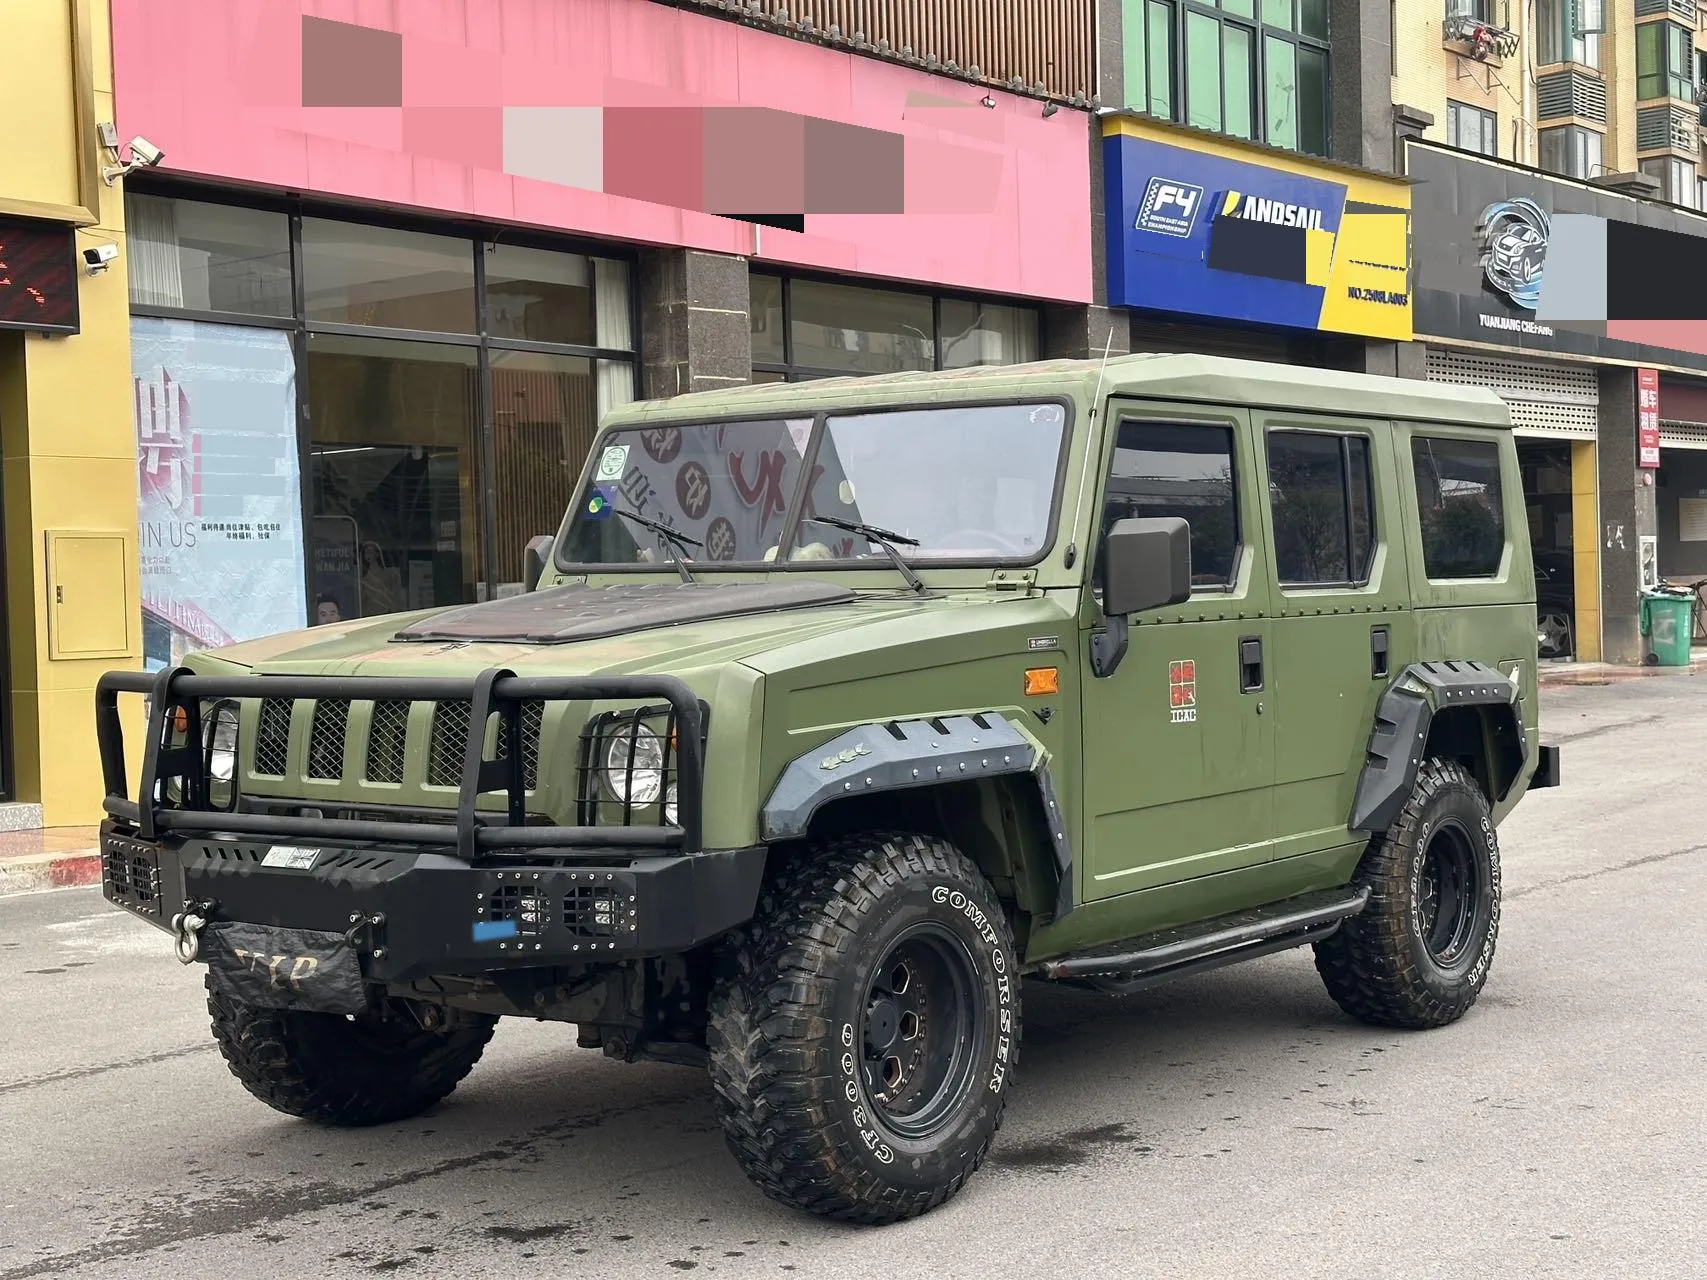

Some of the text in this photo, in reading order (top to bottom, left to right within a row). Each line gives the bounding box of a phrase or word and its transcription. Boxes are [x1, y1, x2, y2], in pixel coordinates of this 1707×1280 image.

[1153, 185, 1197, 217] F4
[1479, 313, 1520, 332] YUANJIANG
[169, 521, 197, 548] US
[1170, 709, 1196, 723] ICAC
[931, 885, 1012, 1093] COMFORSER
[841, 1022, 894, 1164] CF3000
